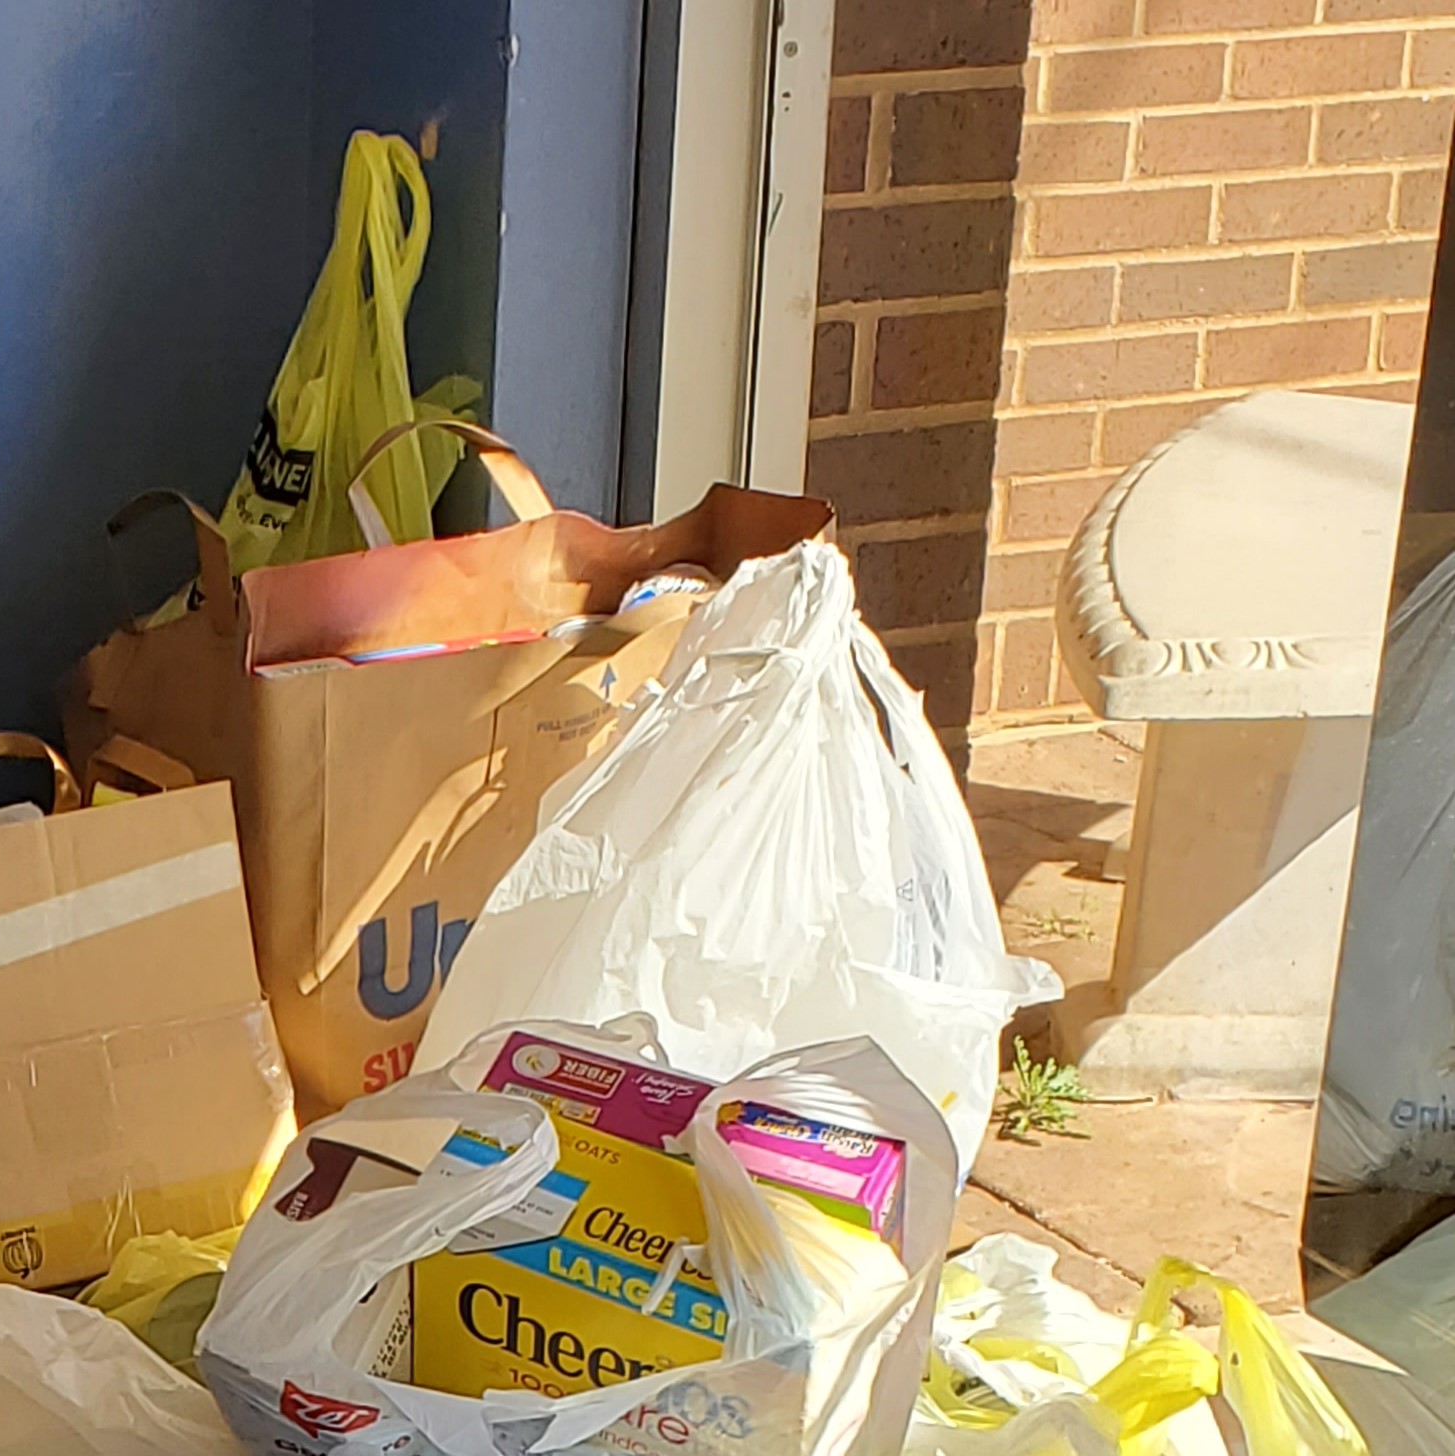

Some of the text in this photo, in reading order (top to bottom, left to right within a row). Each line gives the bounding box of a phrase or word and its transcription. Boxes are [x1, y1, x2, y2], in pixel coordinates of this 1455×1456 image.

[575, 1140, 621, 1165] OATS
[583, 1206, 713, 1281] Cheer
[548, 1246, 728, 1337] LARGE SI
